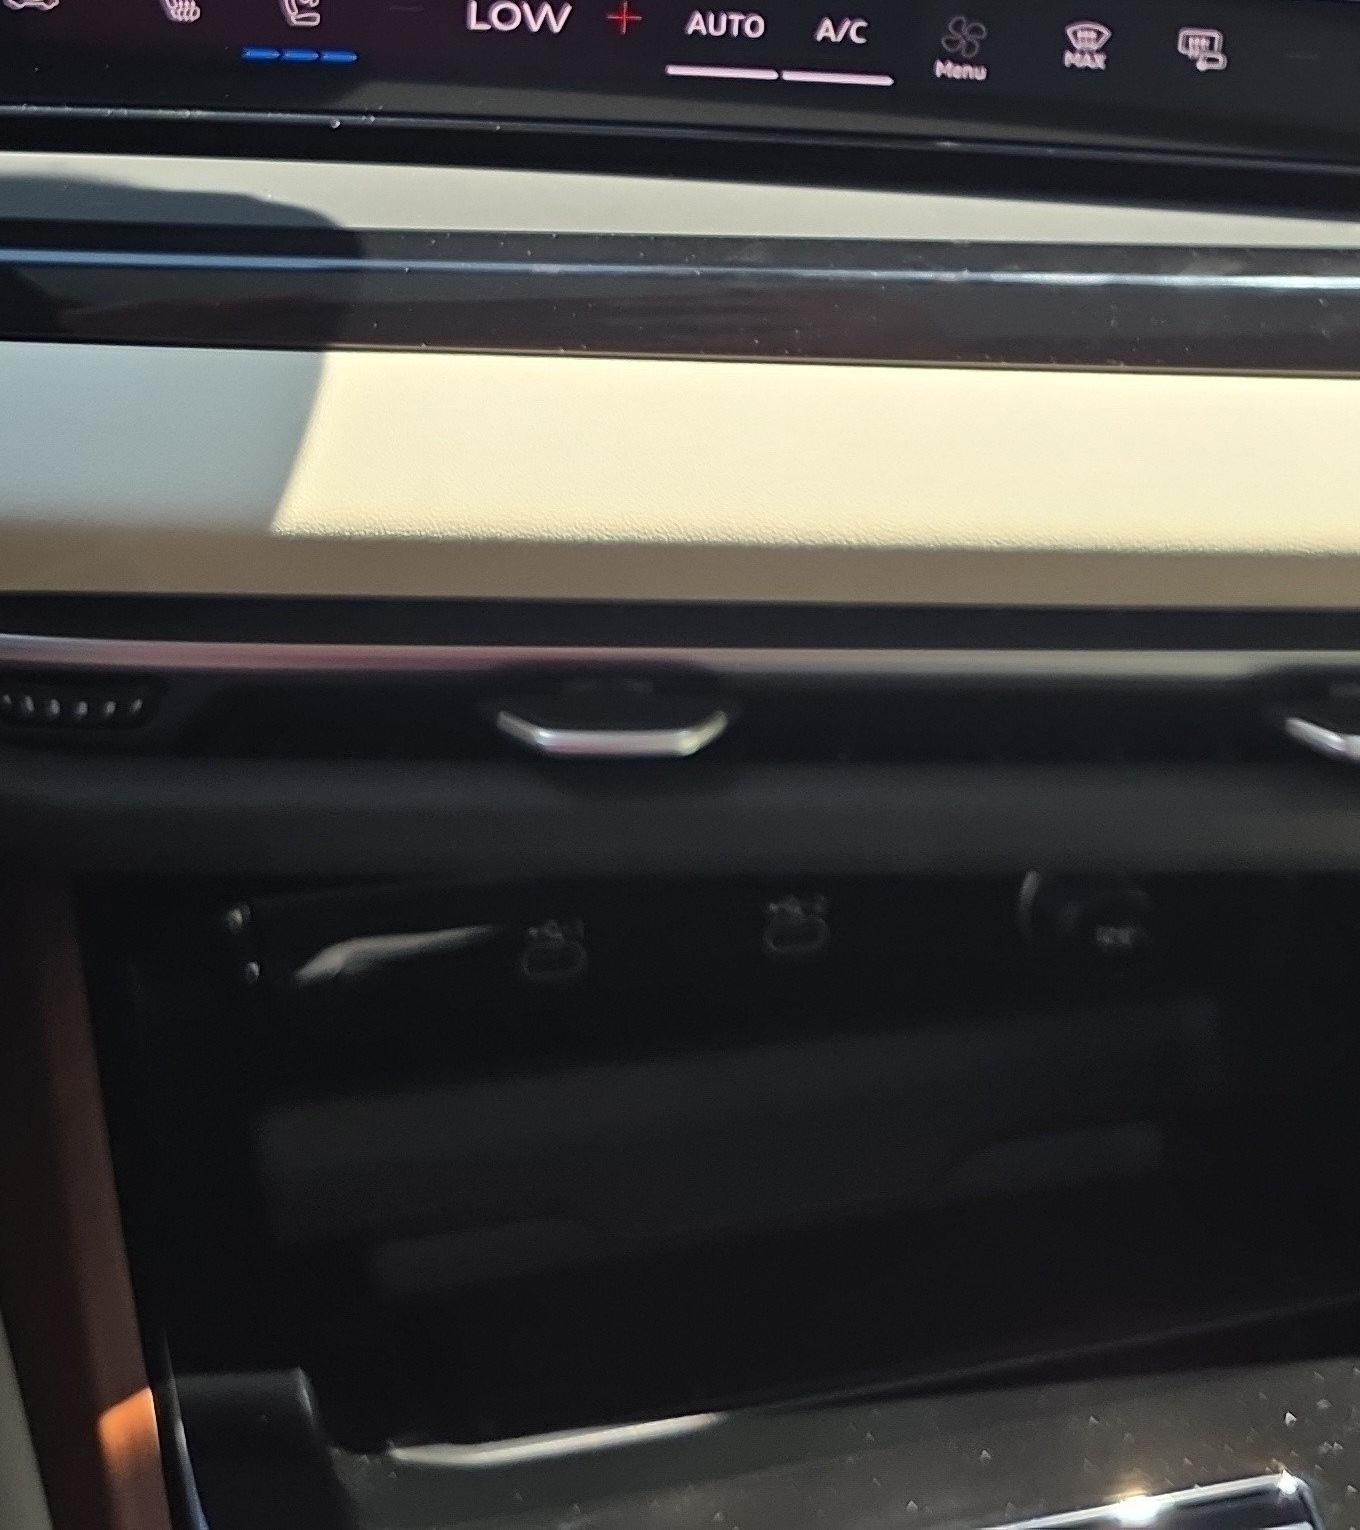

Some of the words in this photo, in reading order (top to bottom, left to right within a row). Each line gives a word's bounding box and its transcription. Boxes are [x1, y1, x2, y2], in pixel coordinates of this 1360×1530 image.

[685, 10, 765, 39] AUTO
[815, 18, 868, 44] A/C
[934, 59, 987, 81] Menu
[1064, 50, 1107, 70] MAX
